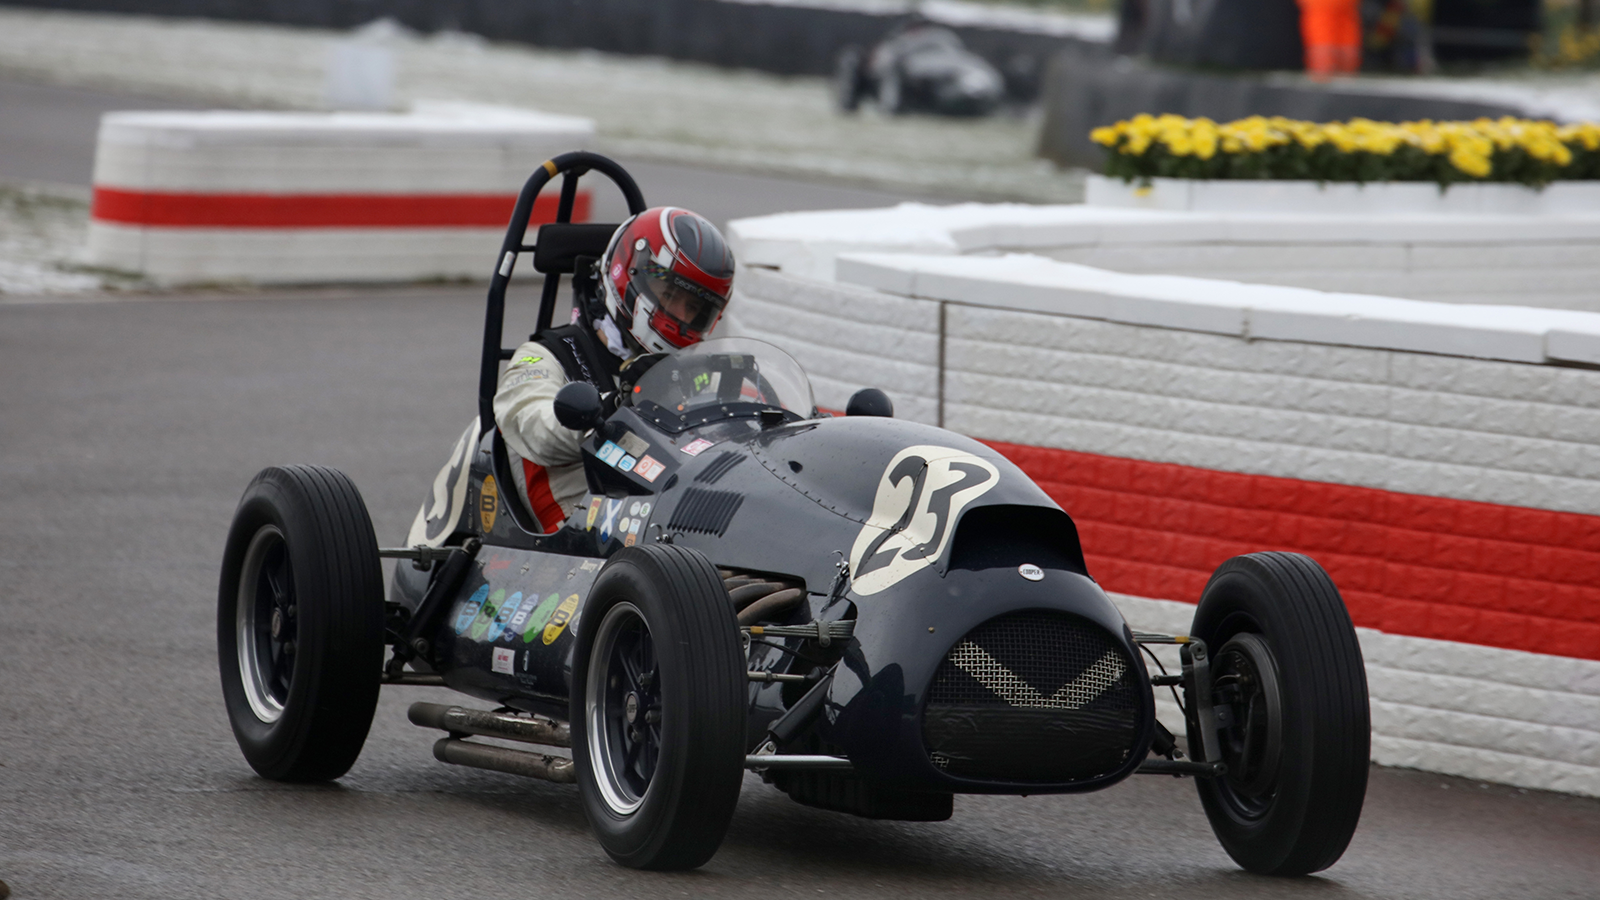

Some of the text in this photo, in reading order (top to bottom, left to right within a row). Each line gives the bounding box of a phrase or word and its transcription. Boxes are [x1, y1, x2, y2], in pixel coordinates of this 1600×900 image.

[481, 494, 496, 513] B
[853, 455, 992, 581] 23
[511, 611, 527, 625] B
[550, 610, 570, 627] B
